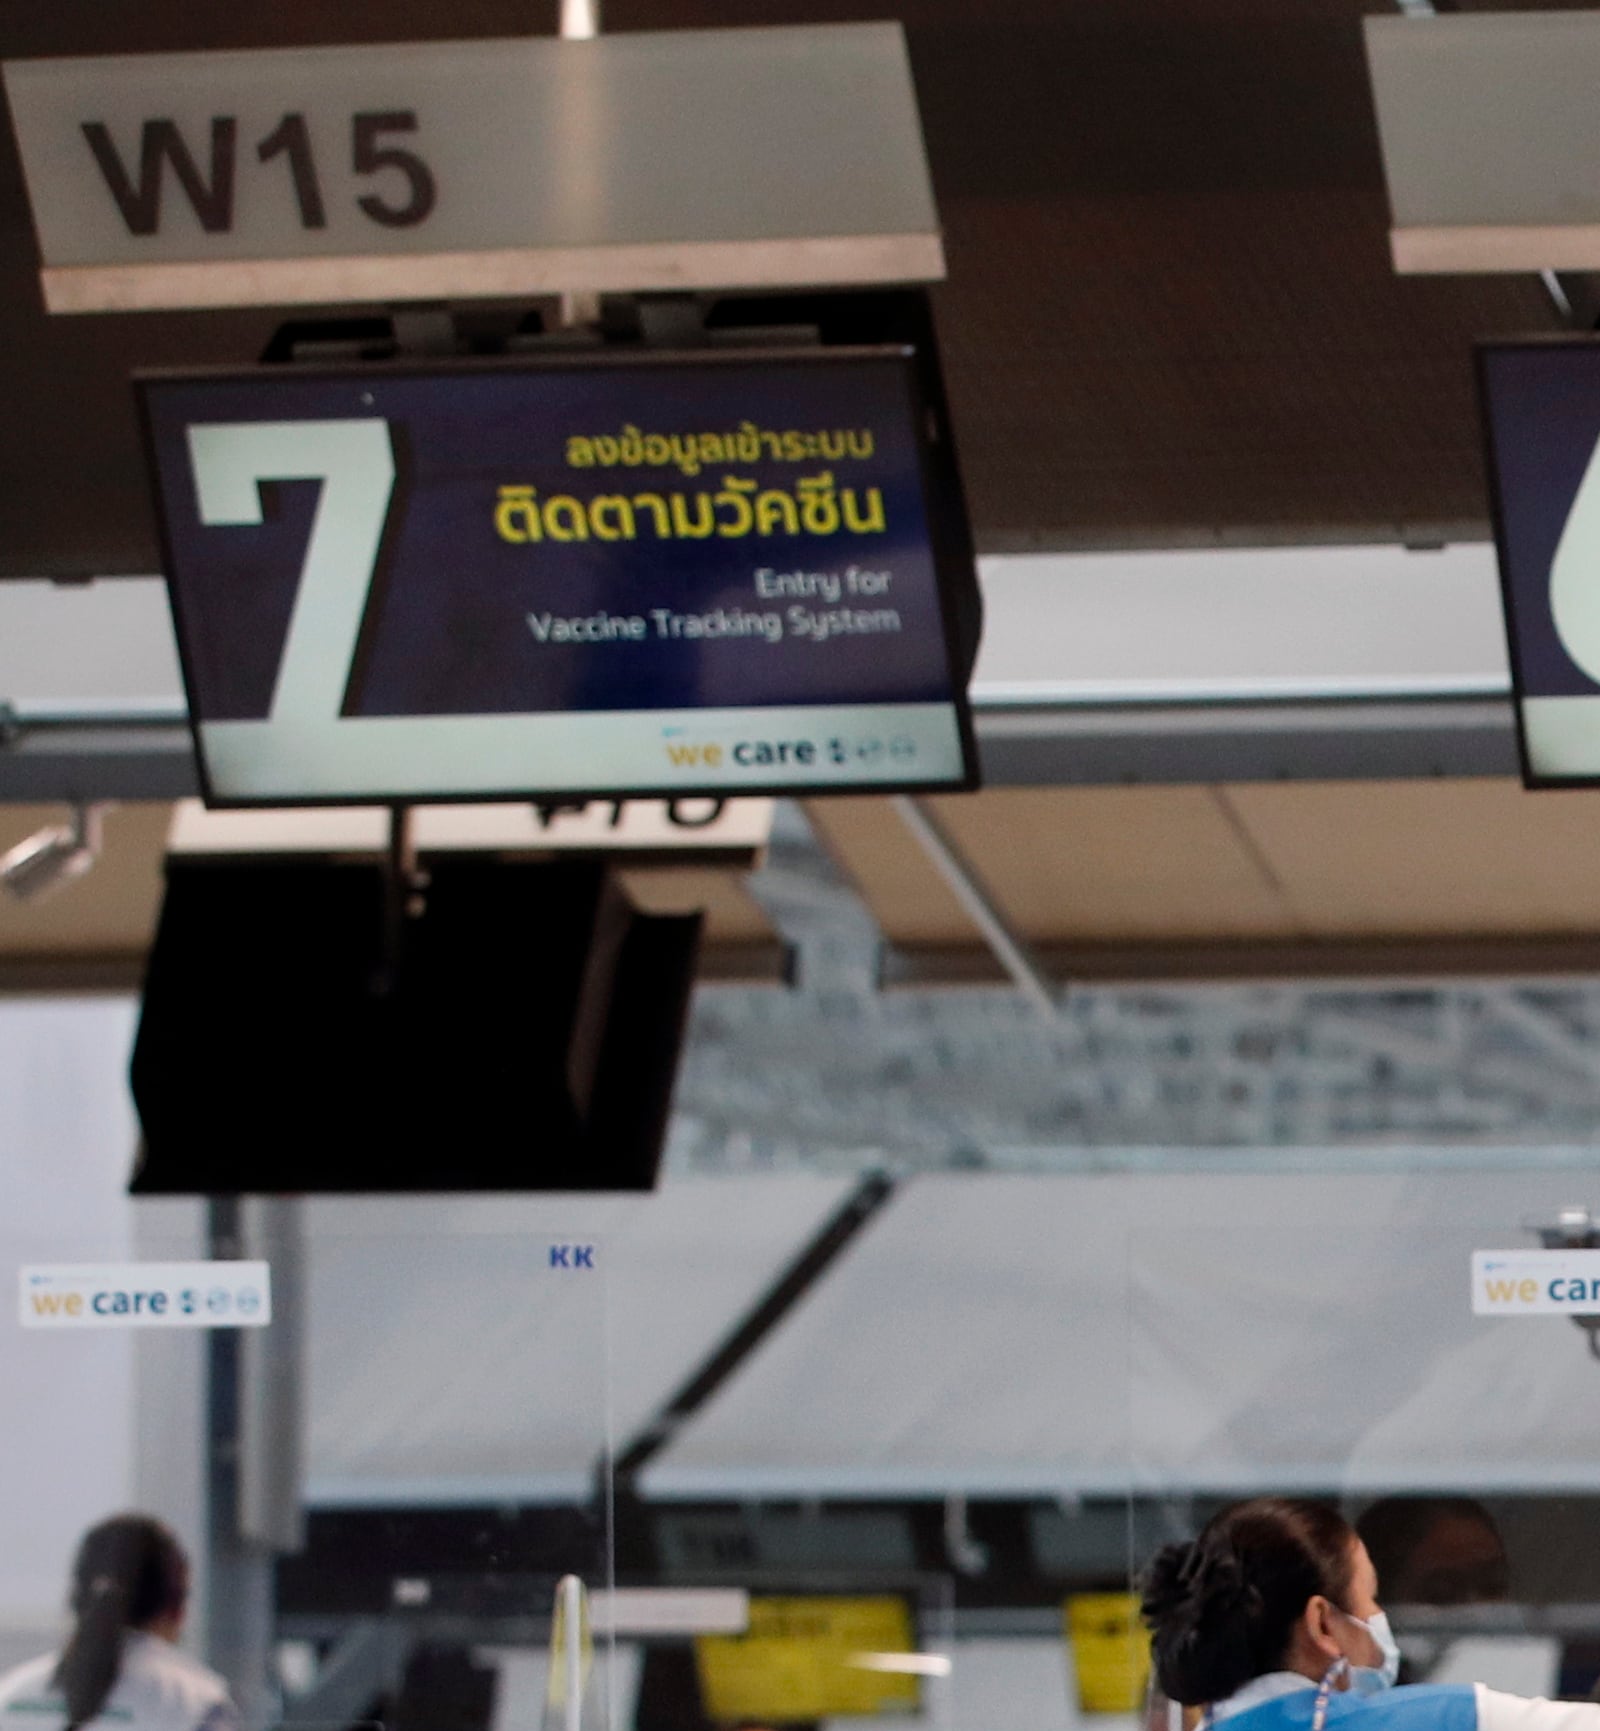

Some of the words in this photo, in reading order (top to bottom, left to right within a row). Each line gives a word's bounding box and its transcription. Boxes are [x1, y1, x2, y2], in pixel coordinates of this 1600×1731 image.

[82, 109, 436, 238] W15
[494, 471, 887, 544] ติดตามวัคซีน
[186, 419, 395, 720] 7
[754, 567, 841, 603] Entry
[846, 565, 893, 597] for
[526, 611, 646, 643] Vaccine
[651, 607, 783, 643] Tracking
[787, 605, 900, 641] System
[666, 743, 724, 768] we
[732, 739, 816, 767] care
[551, 1246, 593, 1267] KK
[32, 1292, 83, 1316] we
[91, 1291, 168, 1315] care
[1485, 1279, 1539, 1302] we
